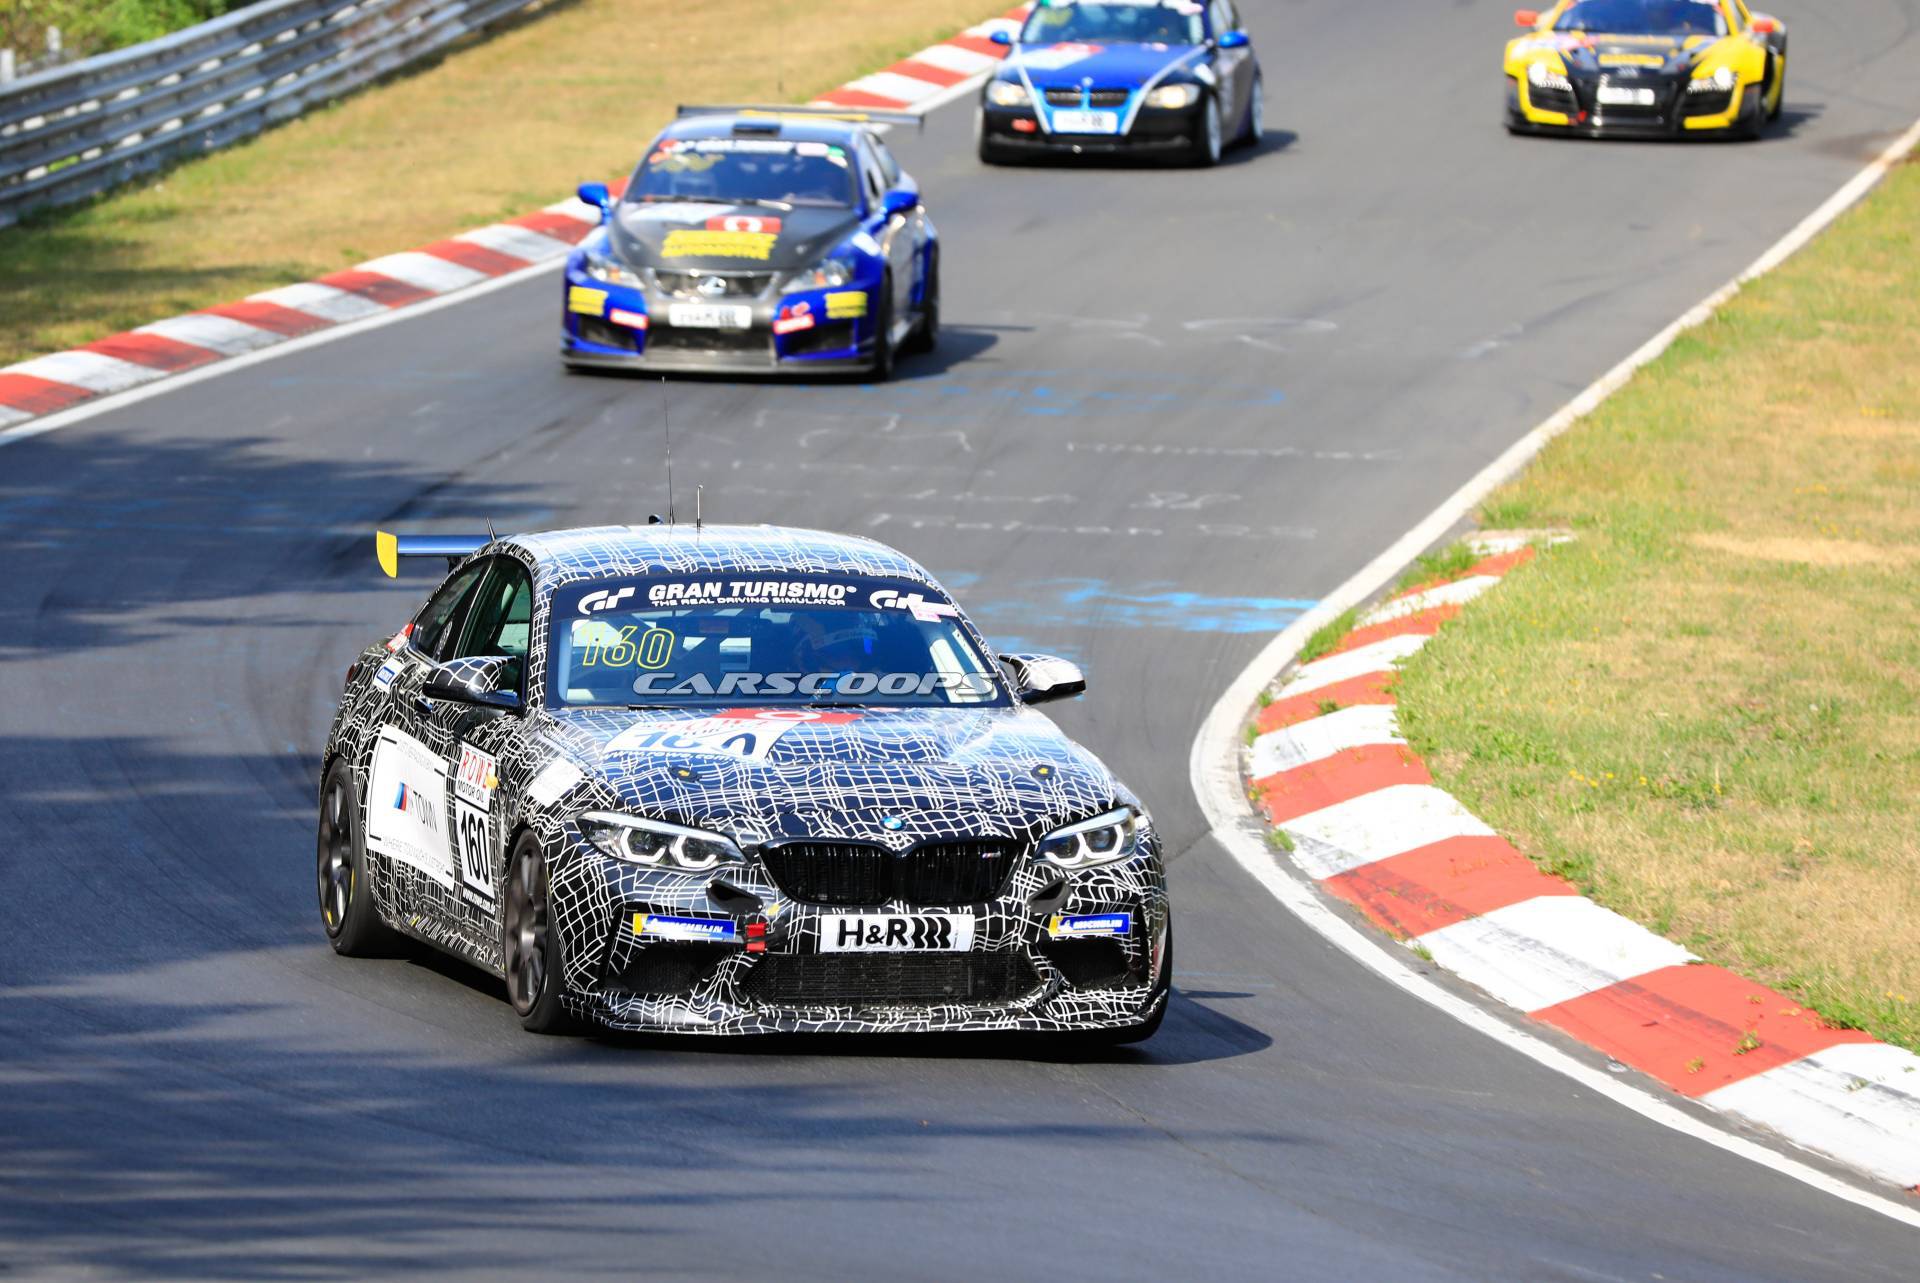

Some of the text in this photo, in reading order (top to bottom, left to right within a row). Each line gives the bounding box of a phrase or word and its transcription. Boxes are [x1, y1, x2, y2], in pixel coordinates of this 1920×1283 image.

[649, 582, 722, 600] GRAN
[772, 597, 846, 607] SIMULATOR
[581, 624, 675, 670] 160
[460, 751, 492, 790] ROWE
[457, 779, 475, 798] MOTOR
[461, 810, 490, 885] 160
